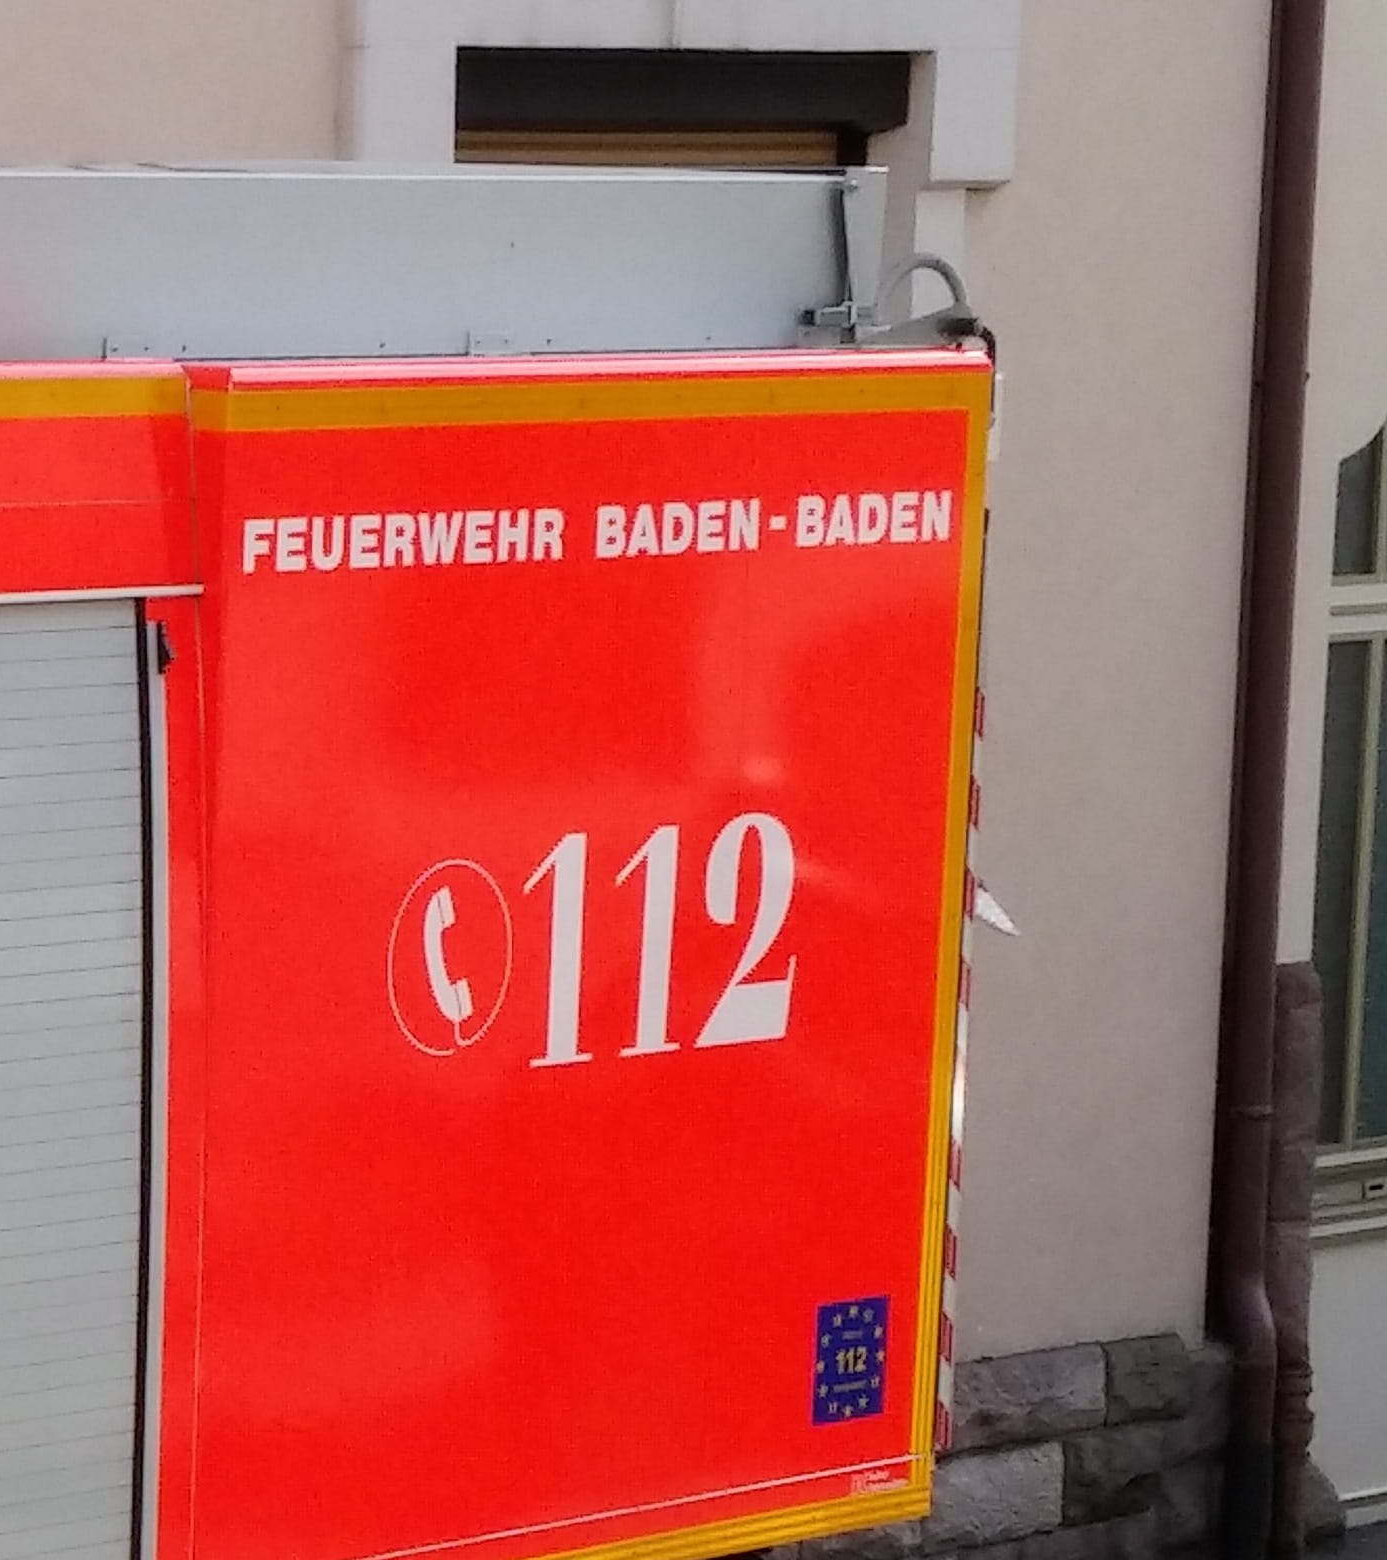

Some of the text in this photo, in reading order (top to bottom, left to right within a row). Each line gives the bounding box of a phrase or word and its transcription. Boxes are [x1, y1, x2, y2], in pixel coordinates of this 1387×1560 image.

[241, 490, 953, 573] FEUERWEHR BADEN-BADEN
[522, 812, 798, 1068] 112
[835, 1346, 868, 1375] 112
